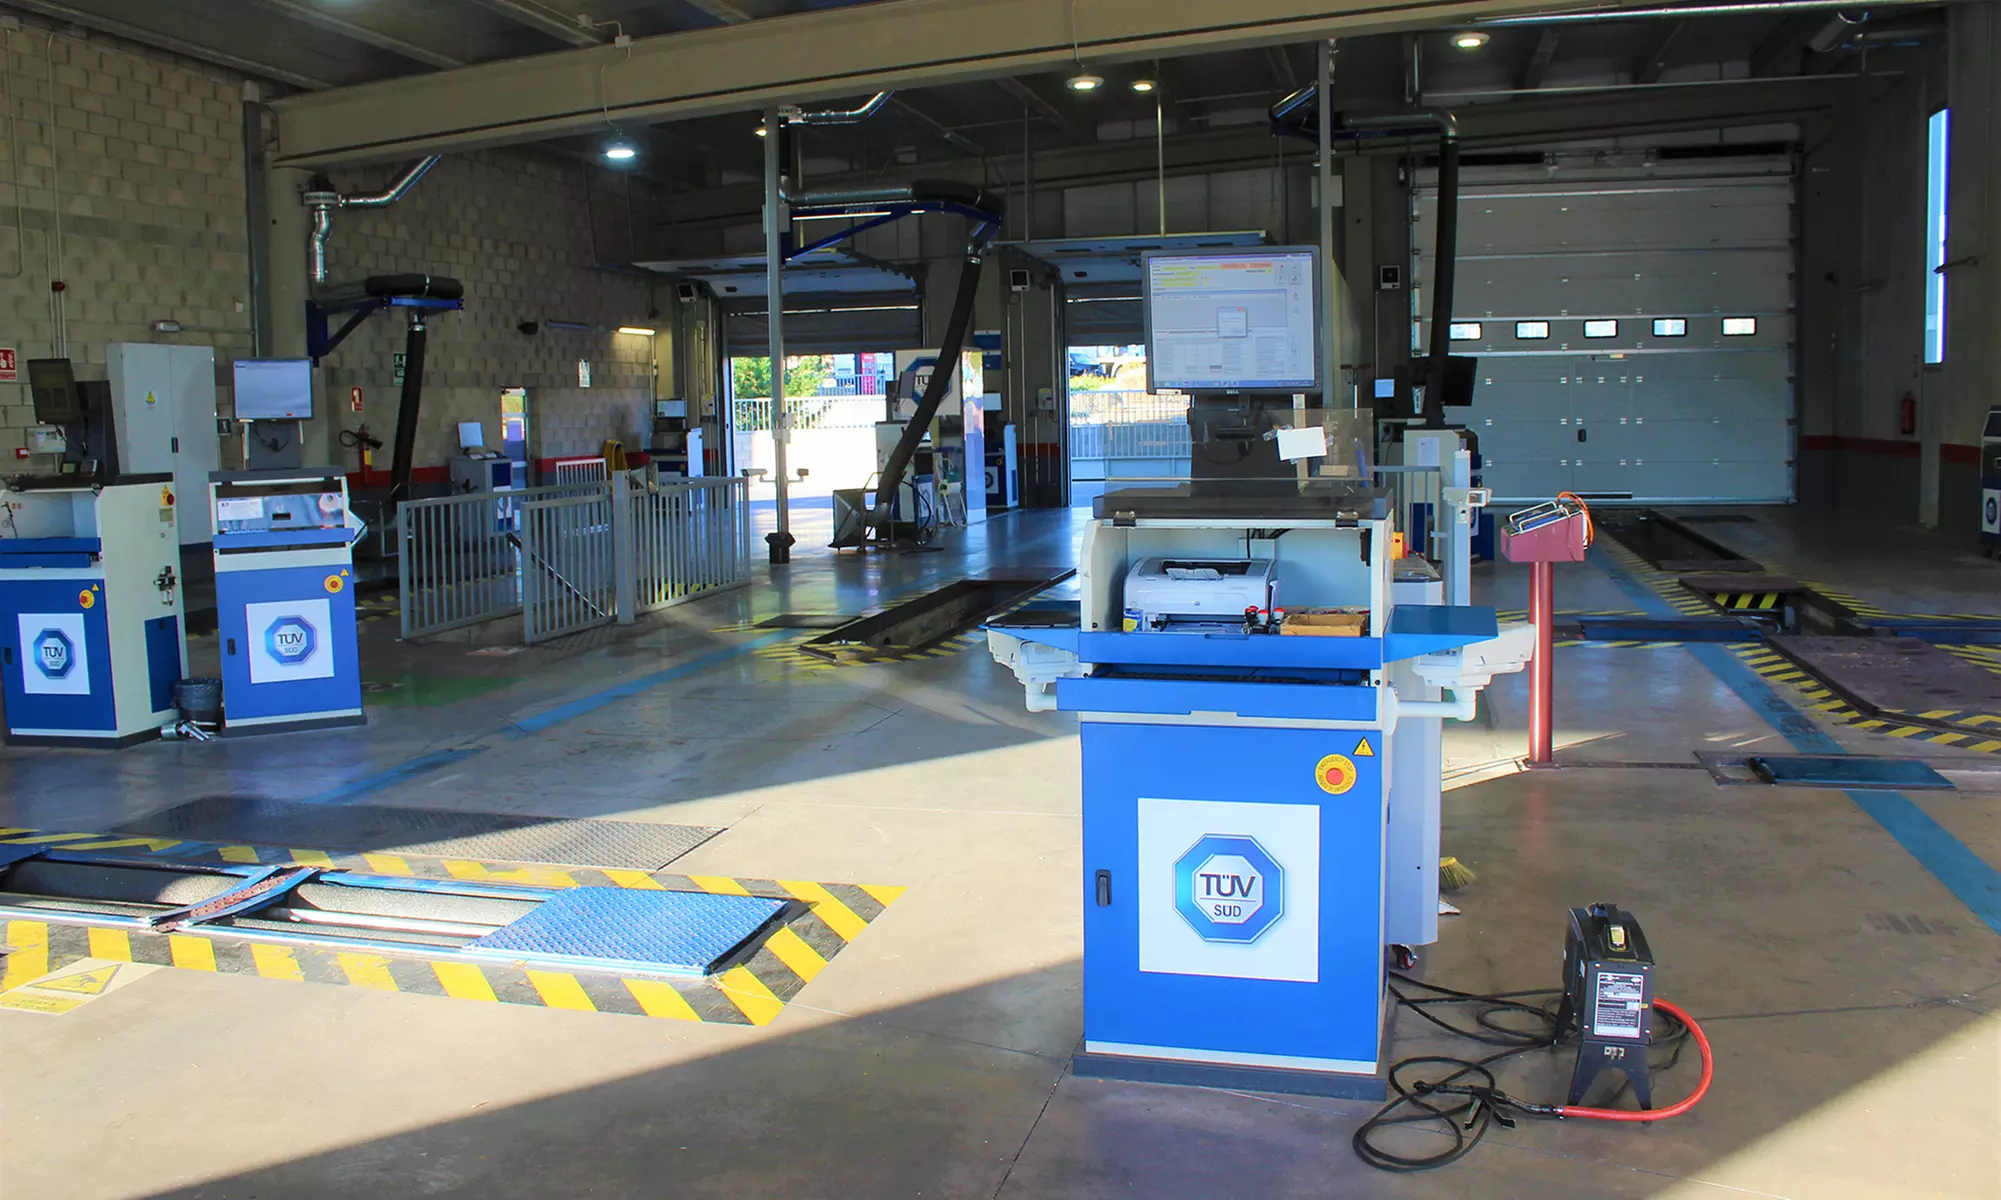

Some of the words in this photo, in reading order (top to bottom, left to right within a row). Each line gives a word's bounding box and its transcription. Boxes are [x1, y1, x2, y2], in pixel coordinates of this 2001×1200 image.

[277, 633, 303, 644] TÜV
[43, 646, 64, 658] TÜV
[1200, 873, 1256, 898] TÜV
